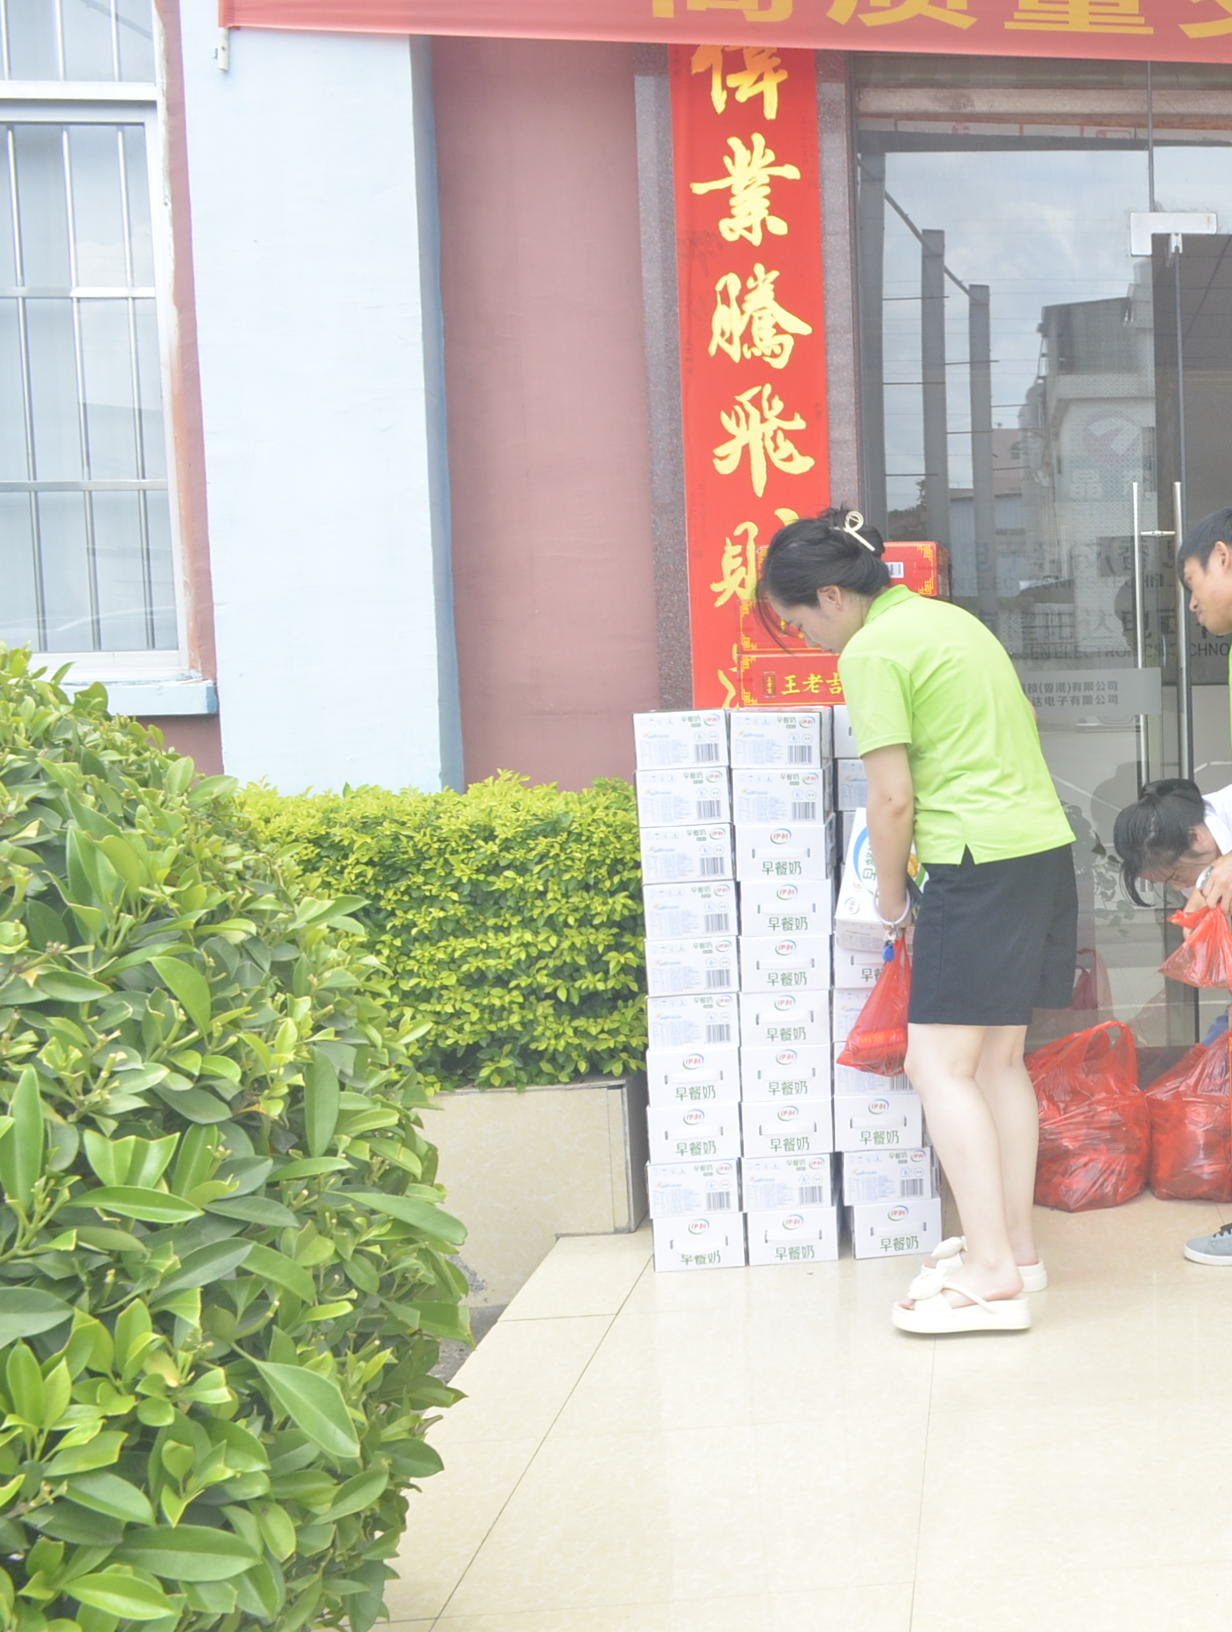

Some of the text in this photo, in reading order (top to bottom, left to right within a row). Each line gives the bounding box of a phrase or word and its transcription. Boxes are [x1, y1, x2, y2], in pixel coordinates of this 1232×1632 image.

[781, 672, 842, 695] 王老吉
[762, 861, 802, 876] 早餐奶
[768, 917, 808, 931] 早餐奶
[767, 972, 807, 987] 早餐奶
[766, 1027, 807, 1042] 早餐奶
[675, 1085, 716, 1101] 早餐奶
[768, 1081, 808, 1096] 早餐奶
[770, 1137, 811, 1152] 早餐奶
[859, 1130, 899, 1145] 早餐奶
[676, 1141, 717, 1157] 早餐奶
[880, 1235, 919, 1251] 早餐奶
[775, 1245, 815, 1261] 早餐奶
